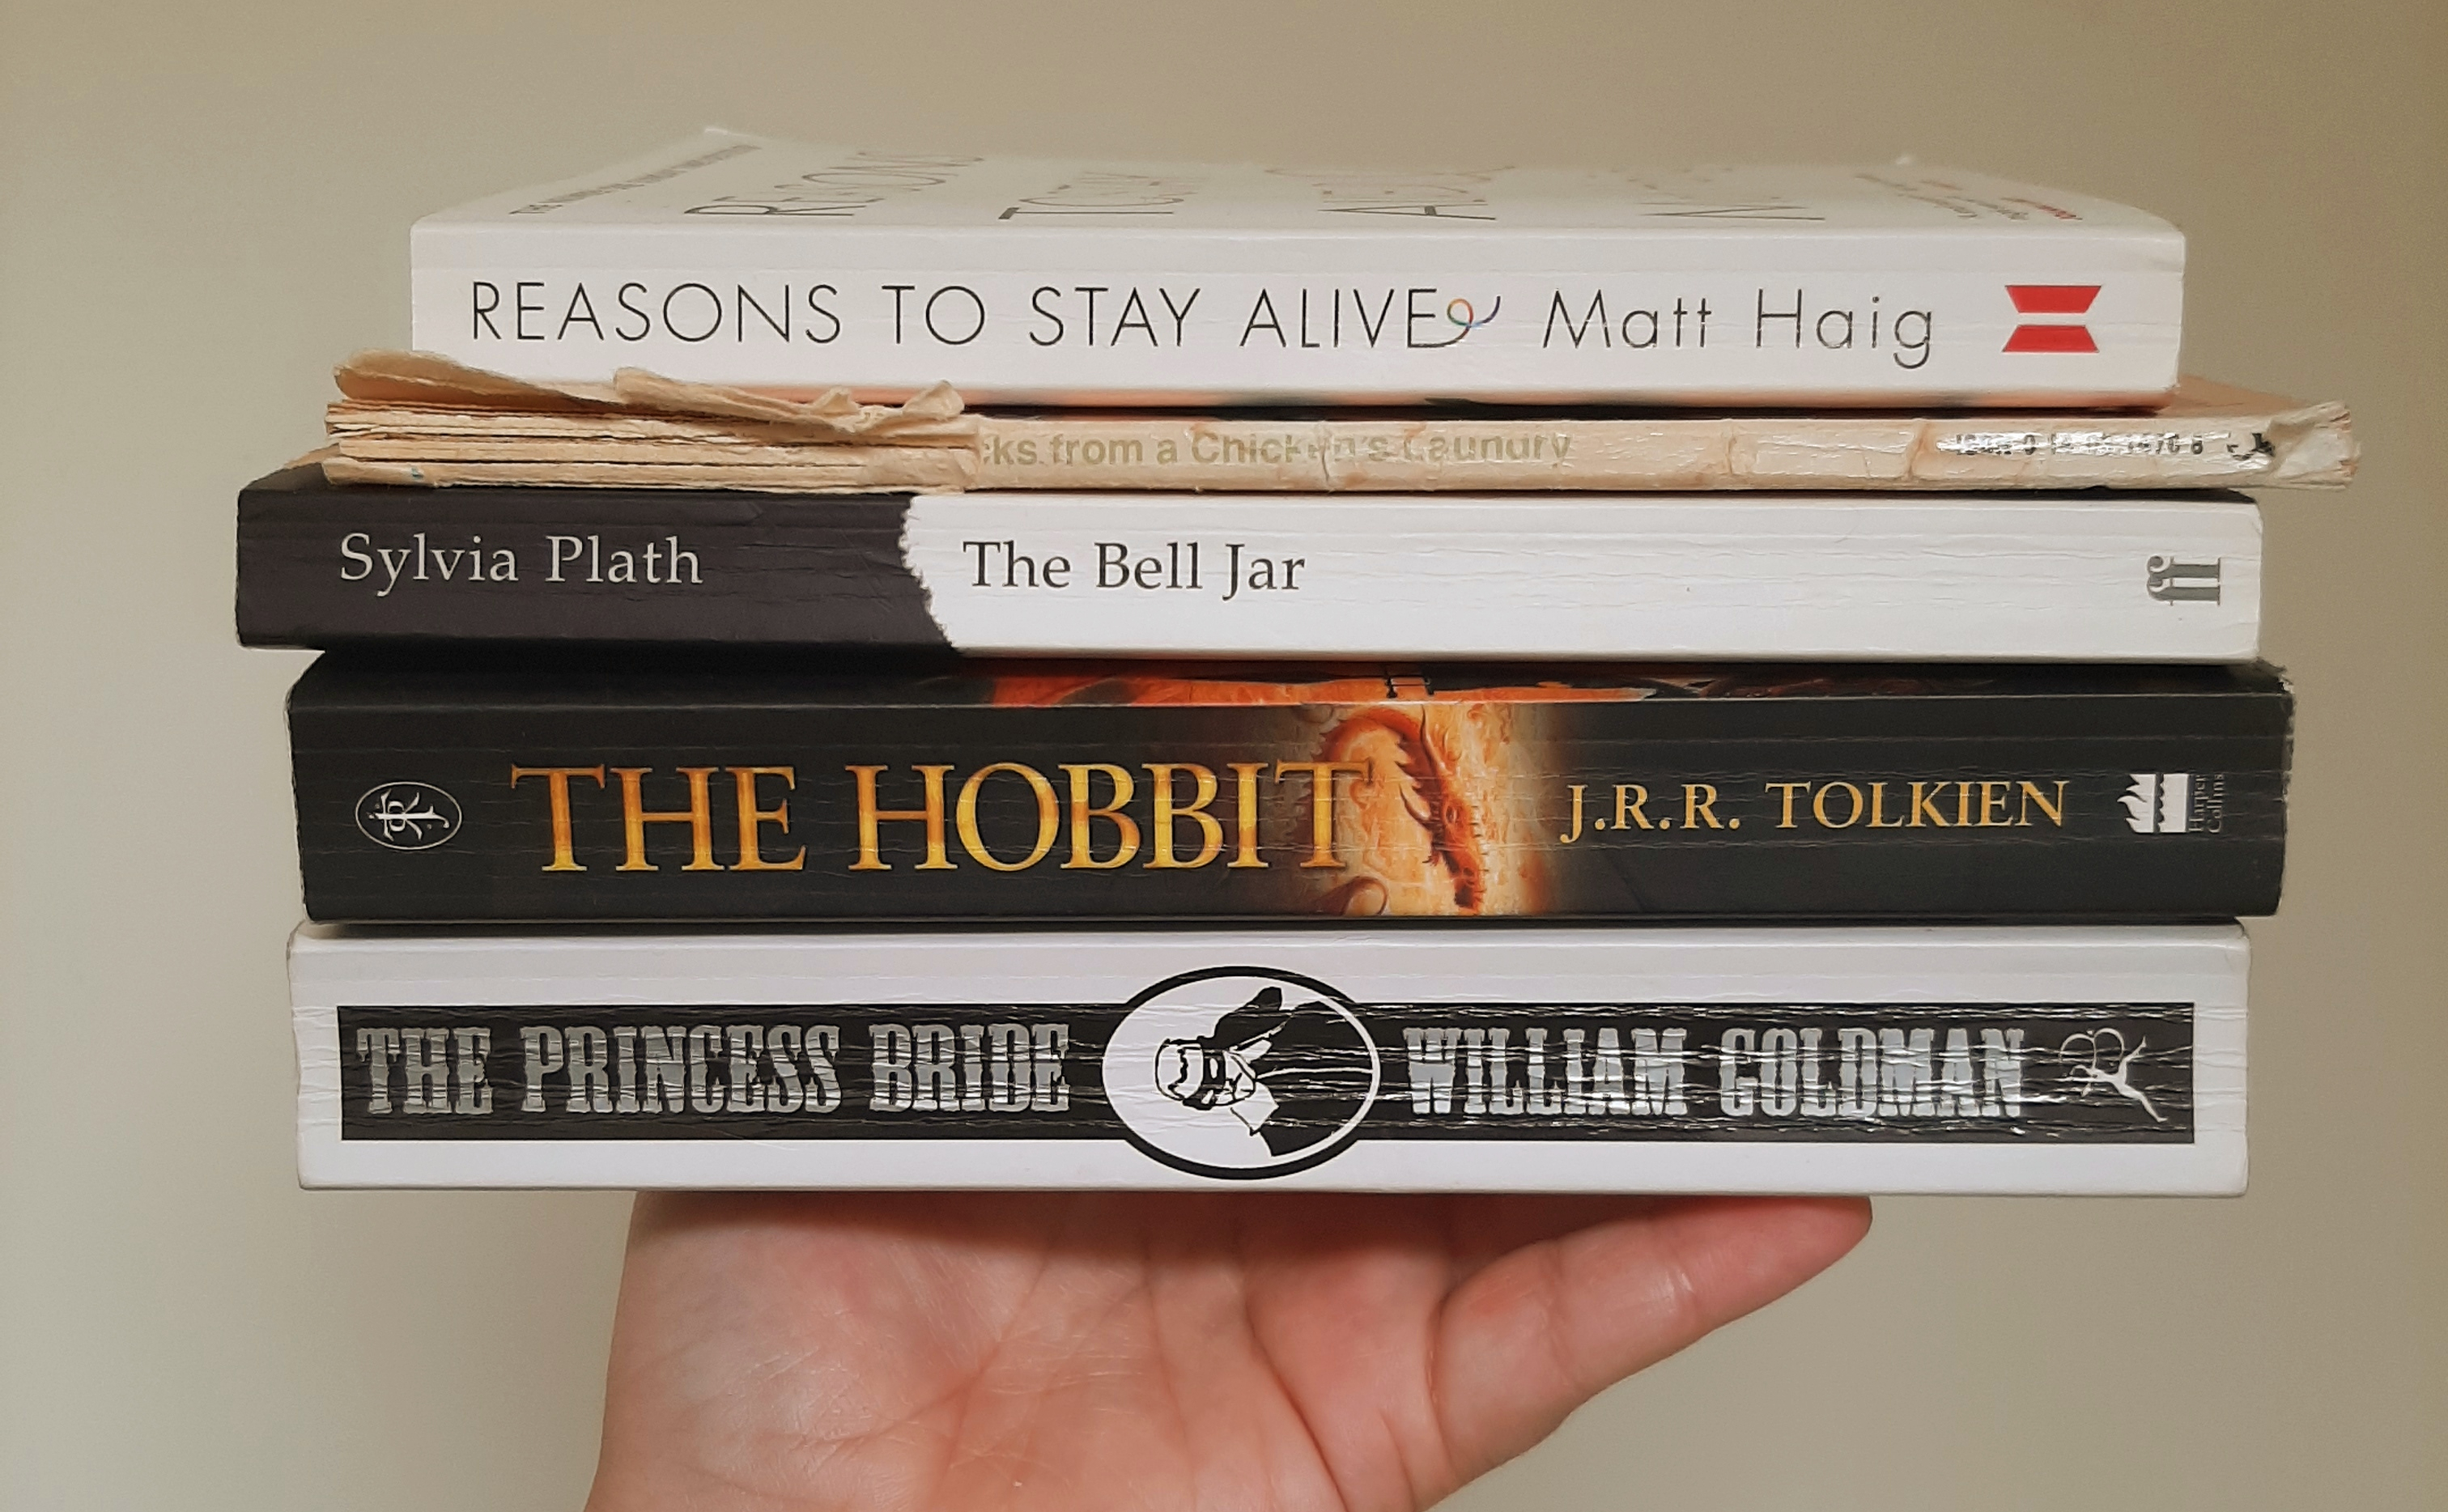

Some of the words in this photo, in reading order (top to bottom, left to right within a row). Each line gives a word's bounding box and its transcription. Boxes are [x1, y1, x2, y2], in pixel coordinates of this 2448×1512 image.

[473, 281, 840, 344] REASONS
[882, 285, 985, 346] TO
[1029, 286, 1201, 347] STAY
[1239, 288, 1501, 349] ALIVE
[1542, 288, 1712, 349] Matt
[1755, 288, 1932, 369] Haig
[983, 434, 1038, 465] ks
[1050, 433, 1143, 465] from
[1157, 439, 1178, 465] a
[340, 532, 519, 597] Sylvia
[545, 534, 703, 584] Plath
[963, 540, 1071, 588] The
[1094, 541, 1204, 590] Bell
[1222, 542, 1306, 601] Jar
[511, 763, 807, 872] THE
[845, 758, 1373, 872] HOBBIT
[1559, 783, 1741, 843] J.R.R.
[1764, 780, 2070, 830] TOLKIEN
[356, 1026, 492, 1115] THE
[520, 1024, 841, 1115] PRINCESS
[868, 1023, 1071, 1114] BRIDE
[1402, 1026, 1688, 1116] WILLIAM
[1717, 1026, 2025, 1117] GOLDMAN
